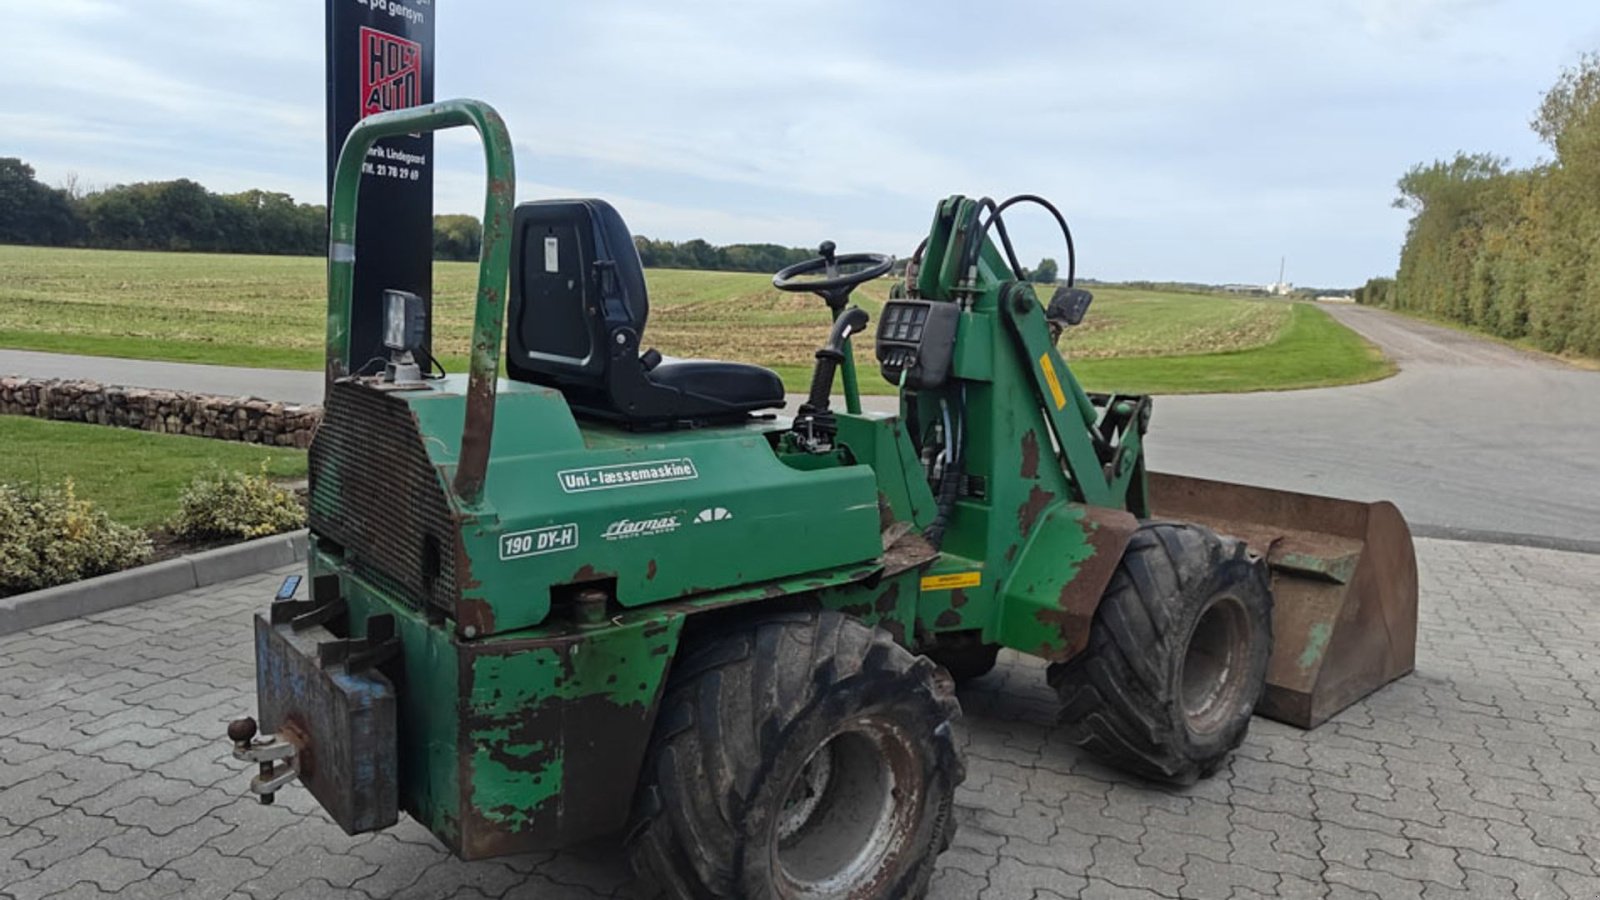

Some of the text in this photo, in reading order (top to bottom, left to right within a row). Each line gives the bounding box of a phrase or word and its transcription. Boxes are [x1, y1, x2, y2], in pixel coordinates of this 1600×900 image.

[388, 2, 424, 24] gensyn
[369, 35, 416, 85] HOLT
[399, 167, 410, 179] 29
[504, 529, 573, 556] 190 DY-H
